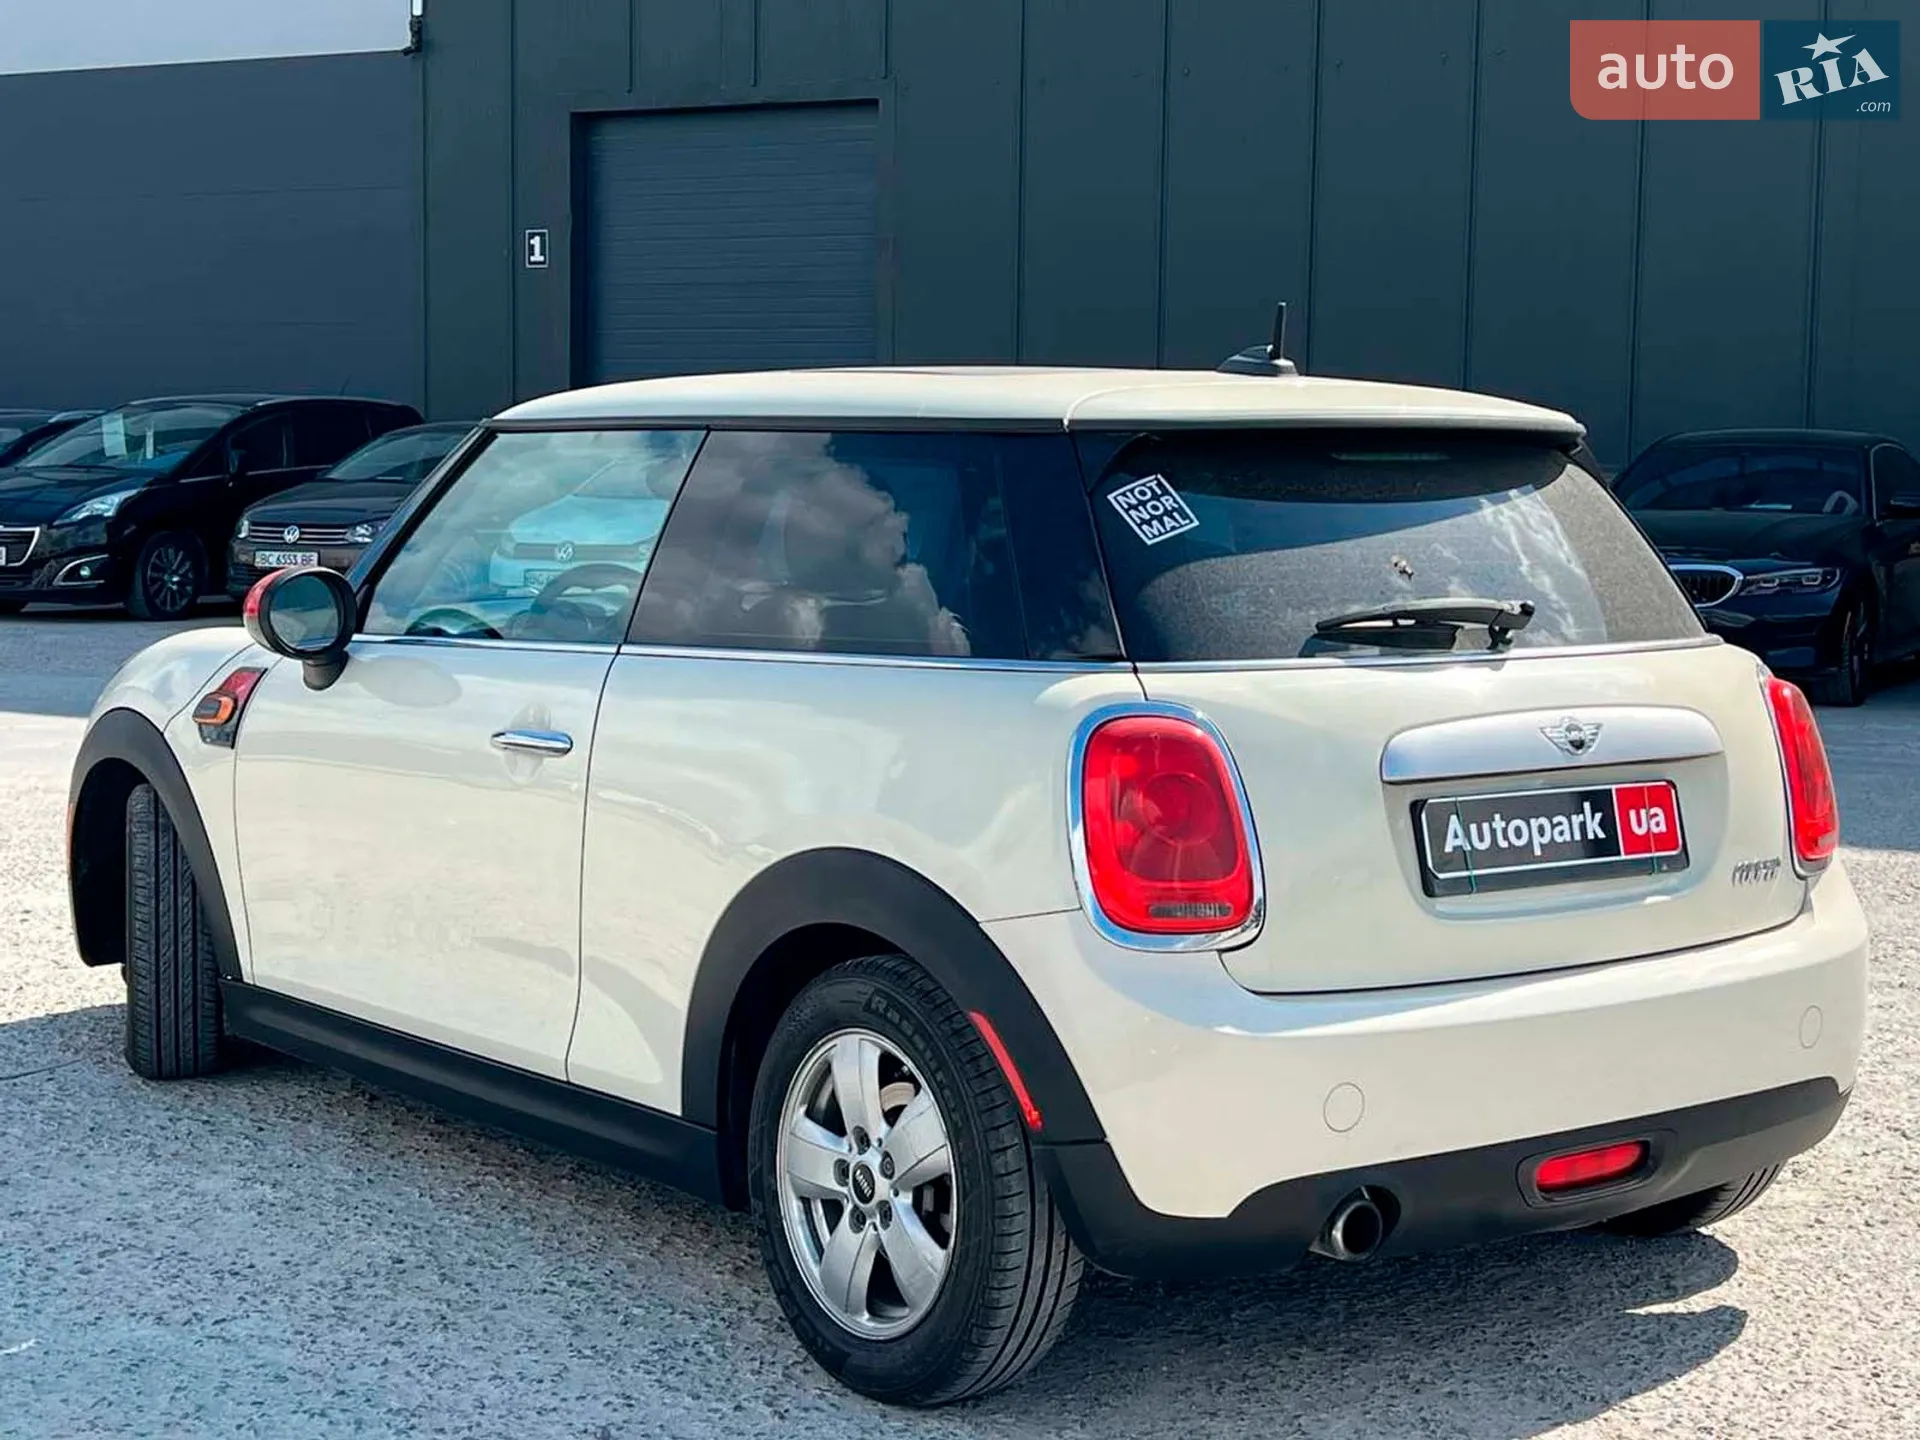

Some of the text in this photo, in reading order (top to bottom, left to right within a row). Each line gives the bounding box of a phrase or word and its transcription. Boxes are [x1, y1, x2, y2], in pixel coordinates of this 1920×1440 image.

[529, 235, 545, 262] 1
[1115, 480, 1163, 510] NOT
[1128, 495, 1180, 525] NOR
[1140, 511, 1191, 539] MAL
[1444, 801, 1668, 856] Autopark ua
